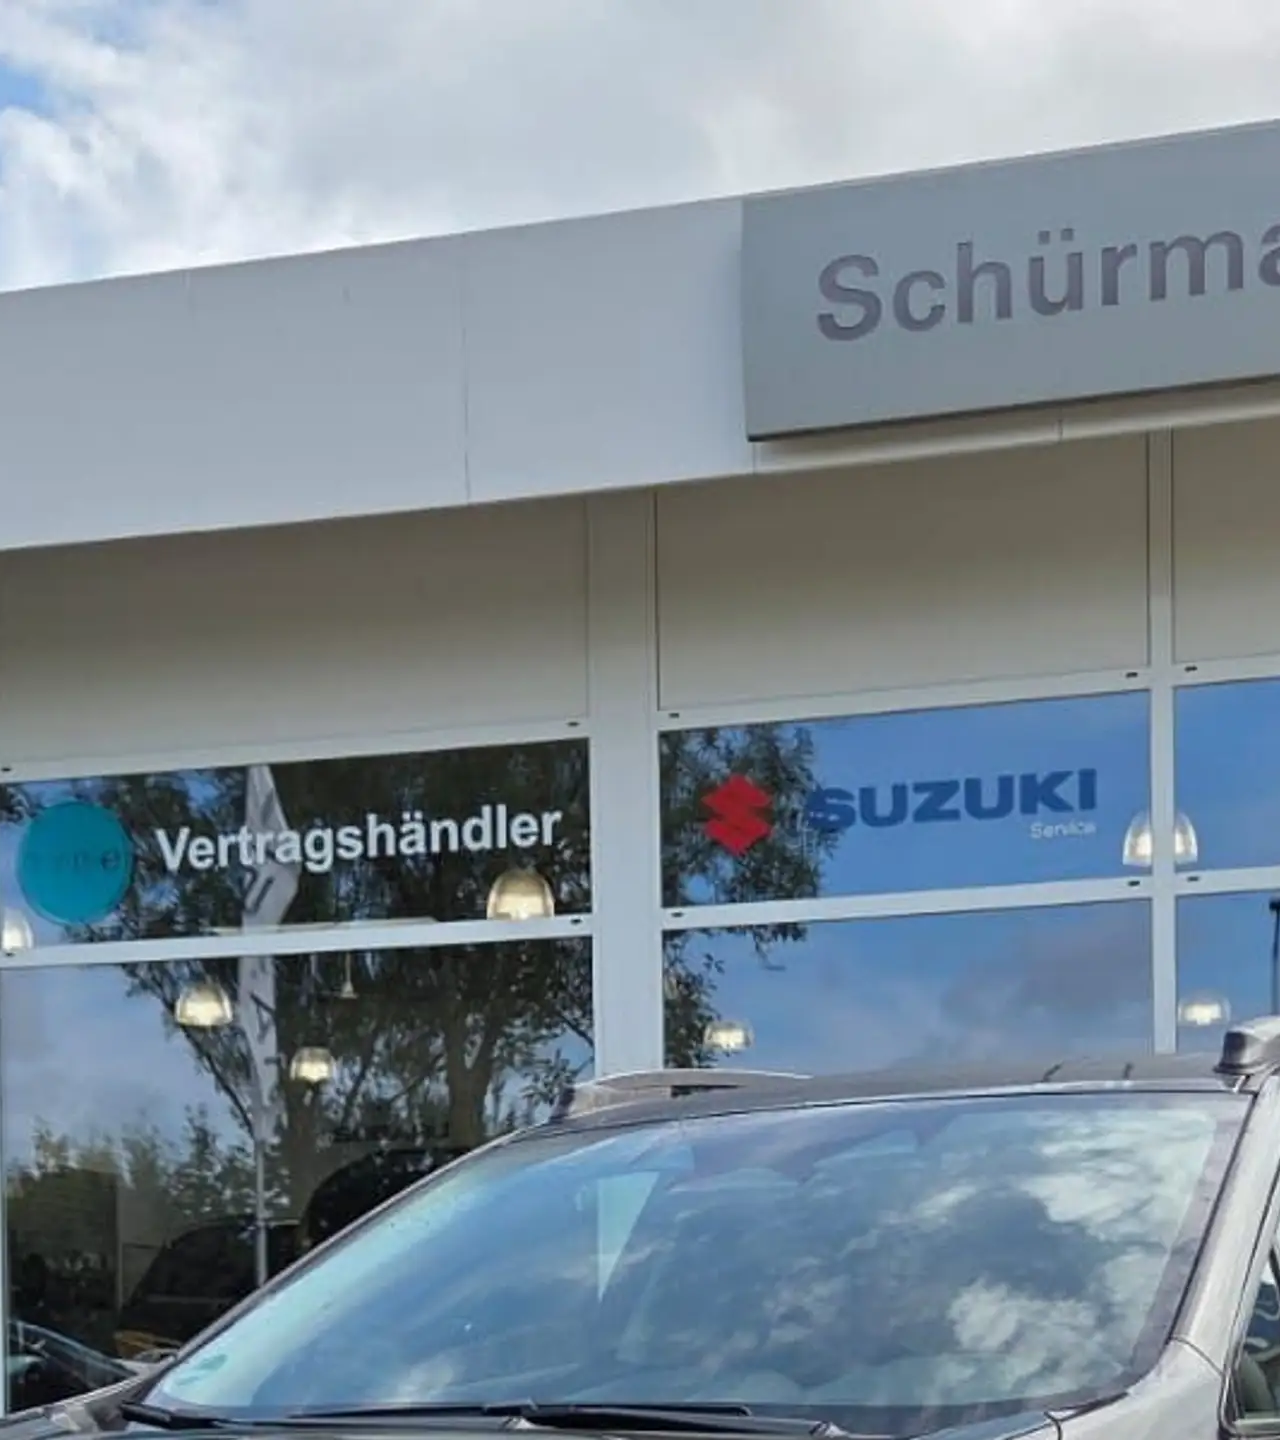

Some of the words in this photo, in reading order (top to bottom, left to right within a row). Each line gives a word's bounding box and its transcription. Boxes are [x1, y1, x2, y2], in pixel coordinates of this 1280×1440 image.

[806, 768, 1097, 830] SUZUKI
[1030, 821, 1097, 839] Service
[155, 803, 563, 875] Vertragshändler
